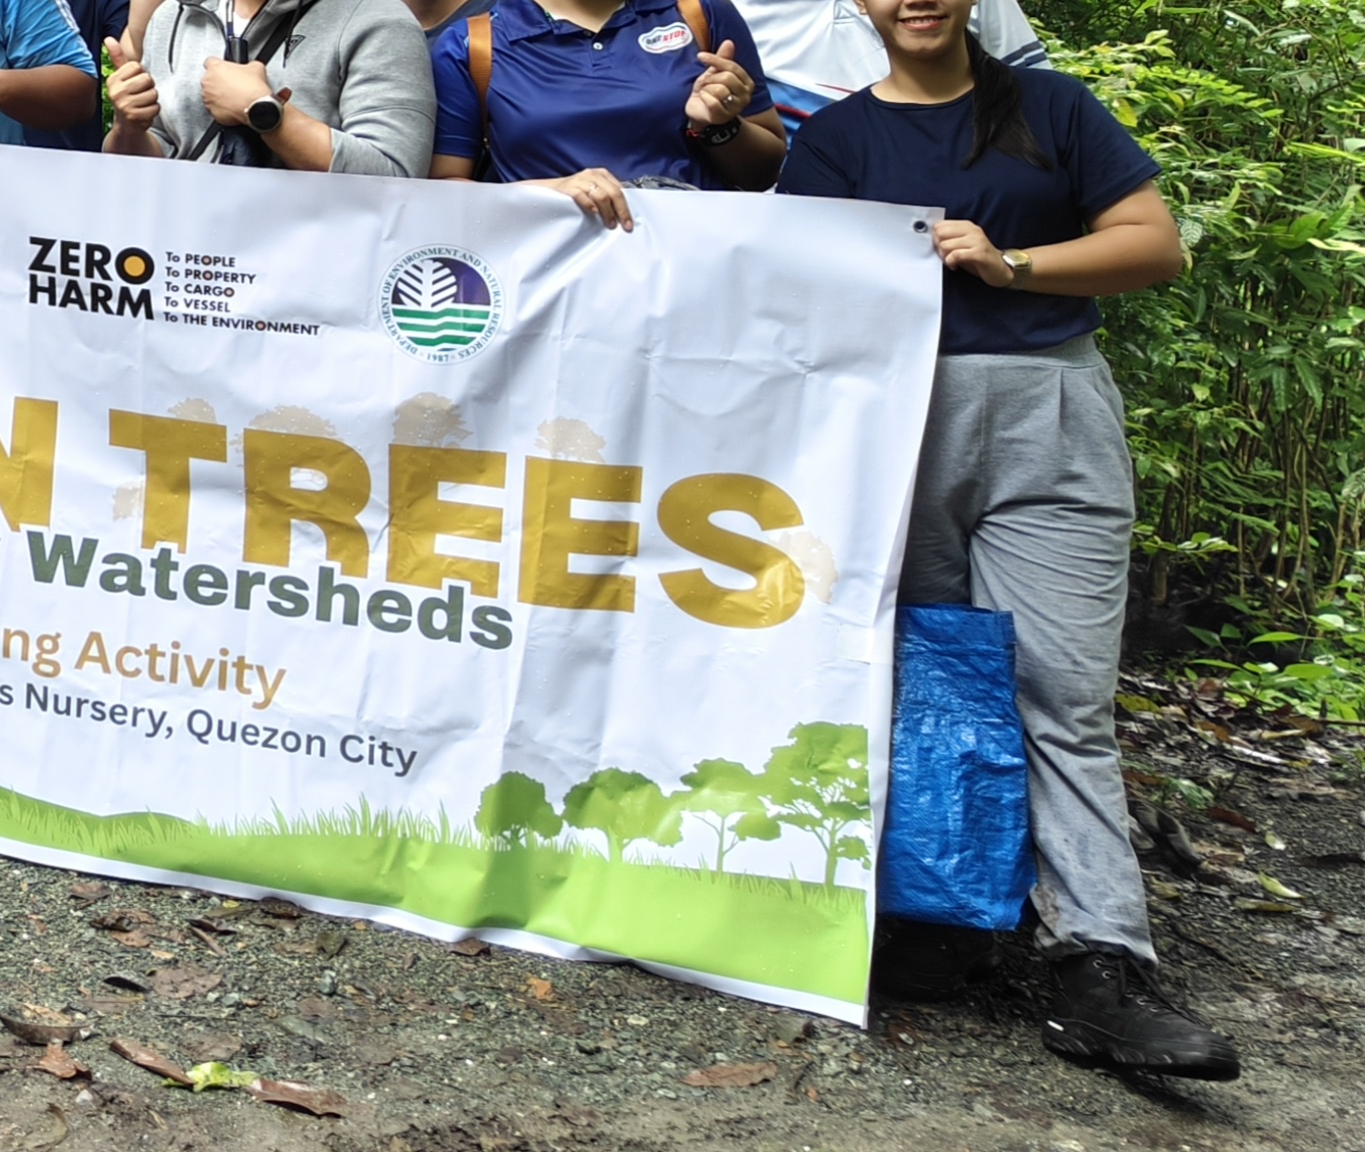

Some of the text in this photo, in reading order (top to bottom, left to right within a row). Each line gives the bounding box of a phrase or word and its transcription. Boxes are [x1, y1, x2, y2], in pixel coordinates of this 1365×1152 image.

[28, 236, 156, 285] ZERO
[165, 251, 236, 268] To PEOPLE
[165, 266, 257, 285] To PROPERTY
[389, 247, 459, 280] ENVIRONMENT
[459, 252, 481, 268] AND
[28, 273, 155, 321] HARM
[164, 281, 236, 299] To CARGO
[164, 296, 231, 314] To VESSEL
[480, 265, 502, 309] NATURAL
[163, 311, 320, 336] To THE ENVIRONMENT
[381, 297, 418, 355] DEPARTMENT
[457, 313, 501, 359] RESOURCES
[108, 408, 806, 629] TREES
[26, 529, 513, 651] Watersheds
[74, 630, 287, 711] Activity
[25, 682, 174, 739] Nursery,
[186, 709, 327, 758] Quezon
[339, 734, 418, 778] City
